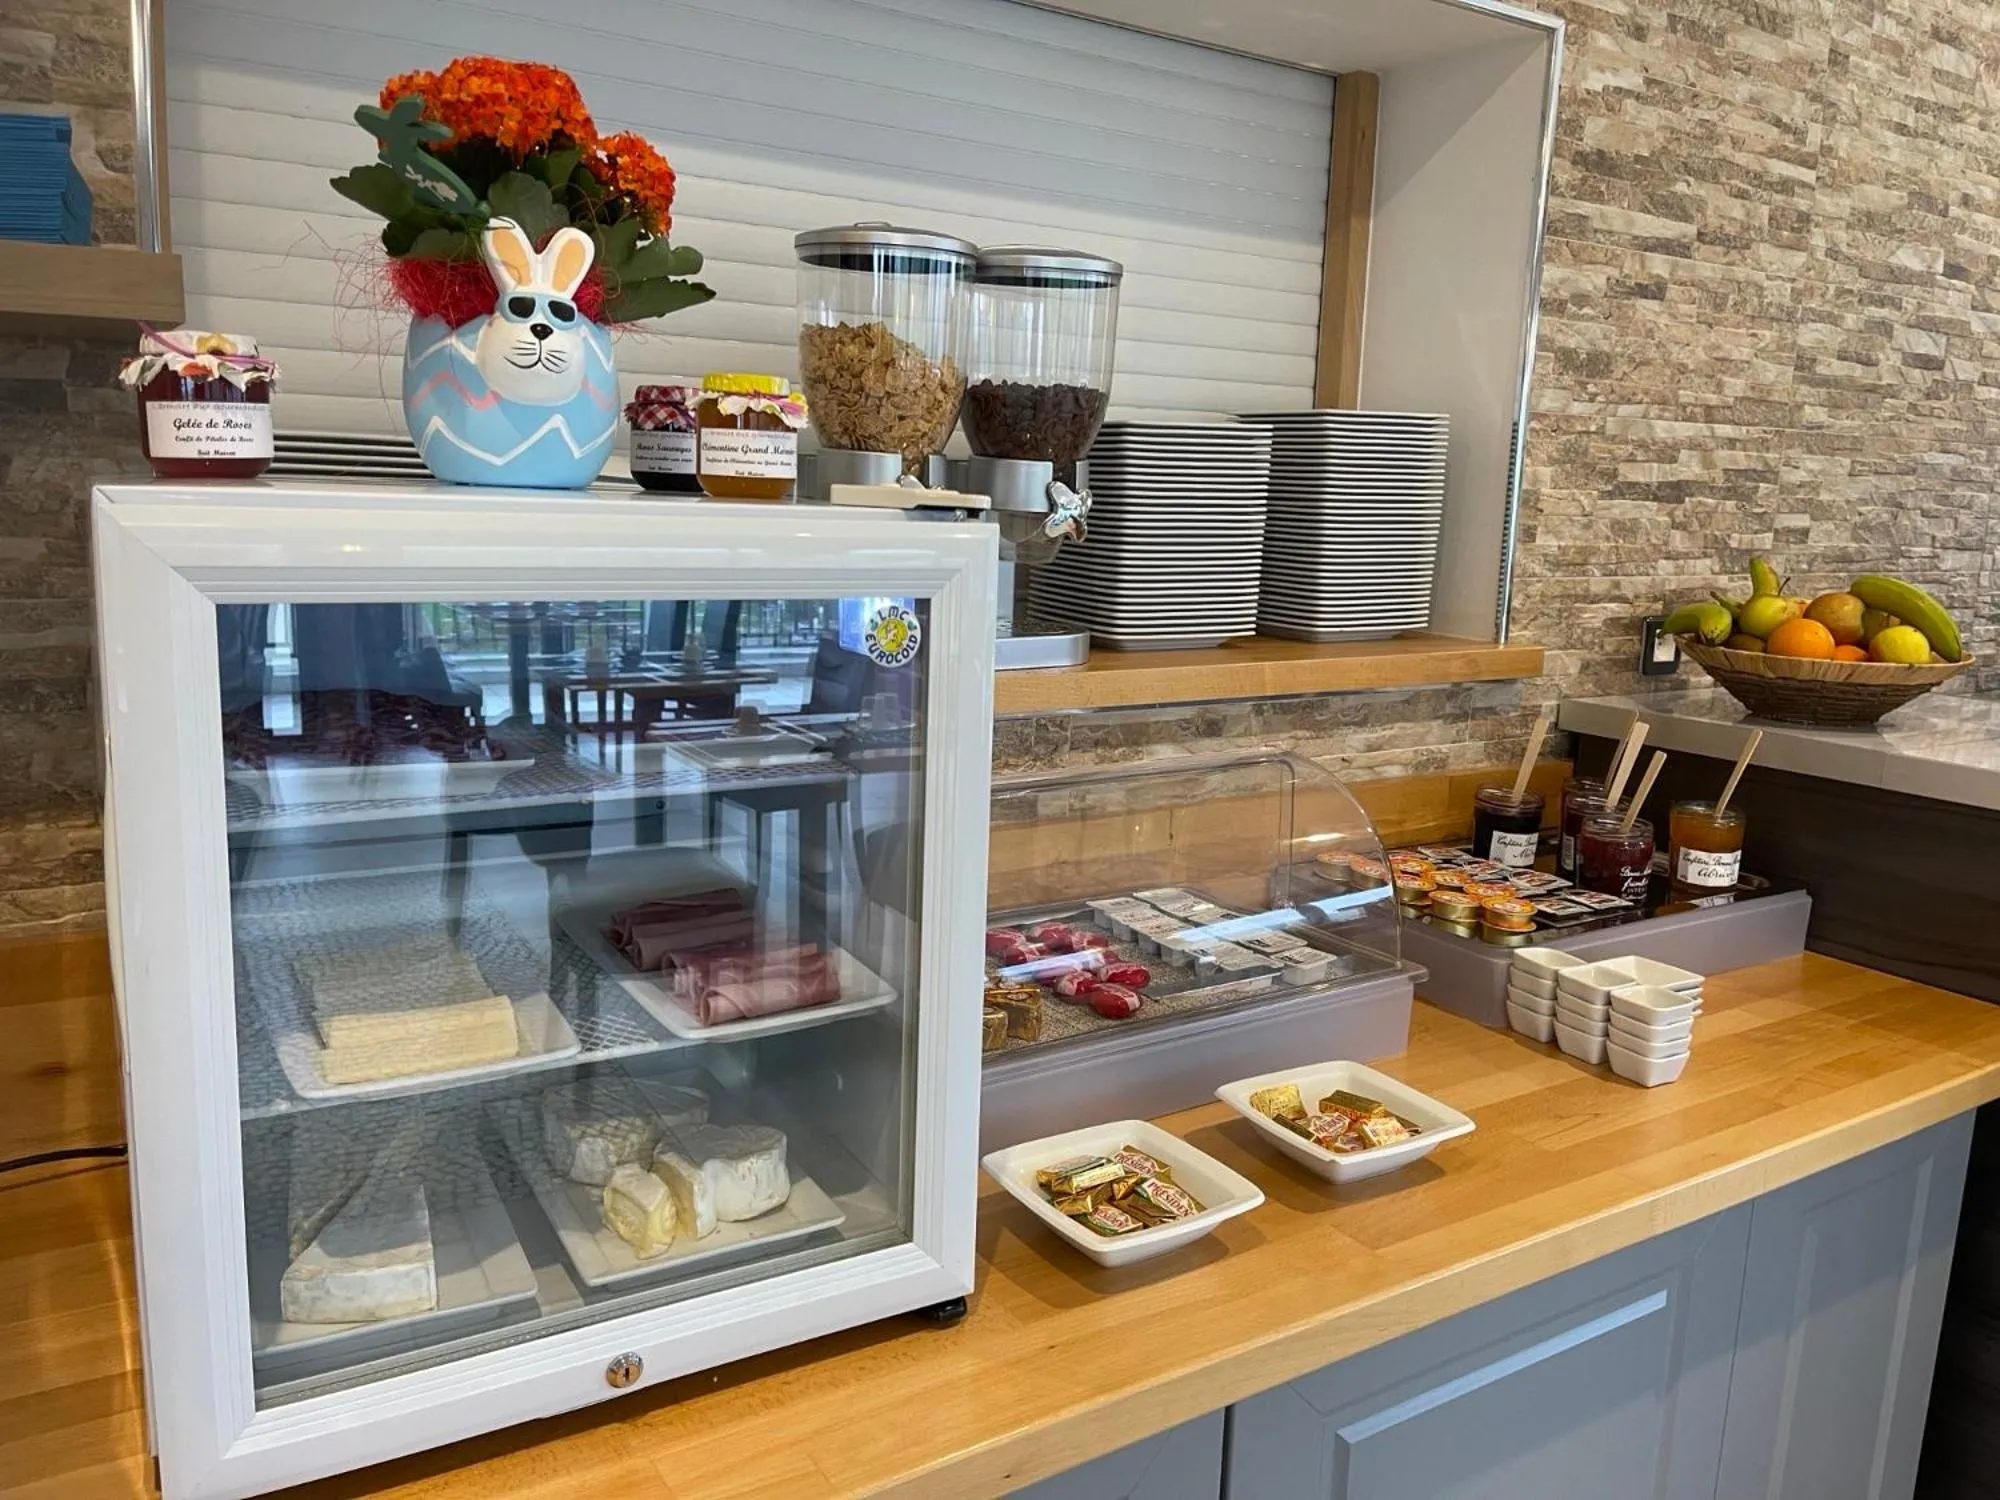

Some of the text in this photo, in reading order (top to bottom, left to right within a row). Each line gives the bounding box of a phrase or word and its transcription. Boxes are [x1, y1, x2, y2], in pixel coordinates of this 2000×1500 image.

[172, 417, 253, 431] Gelée de Roses
[741, 443, 769, 456] Grand
[877, 606, 910, 621] LMC
[865, 633, 918, 664] EUROCOLD
